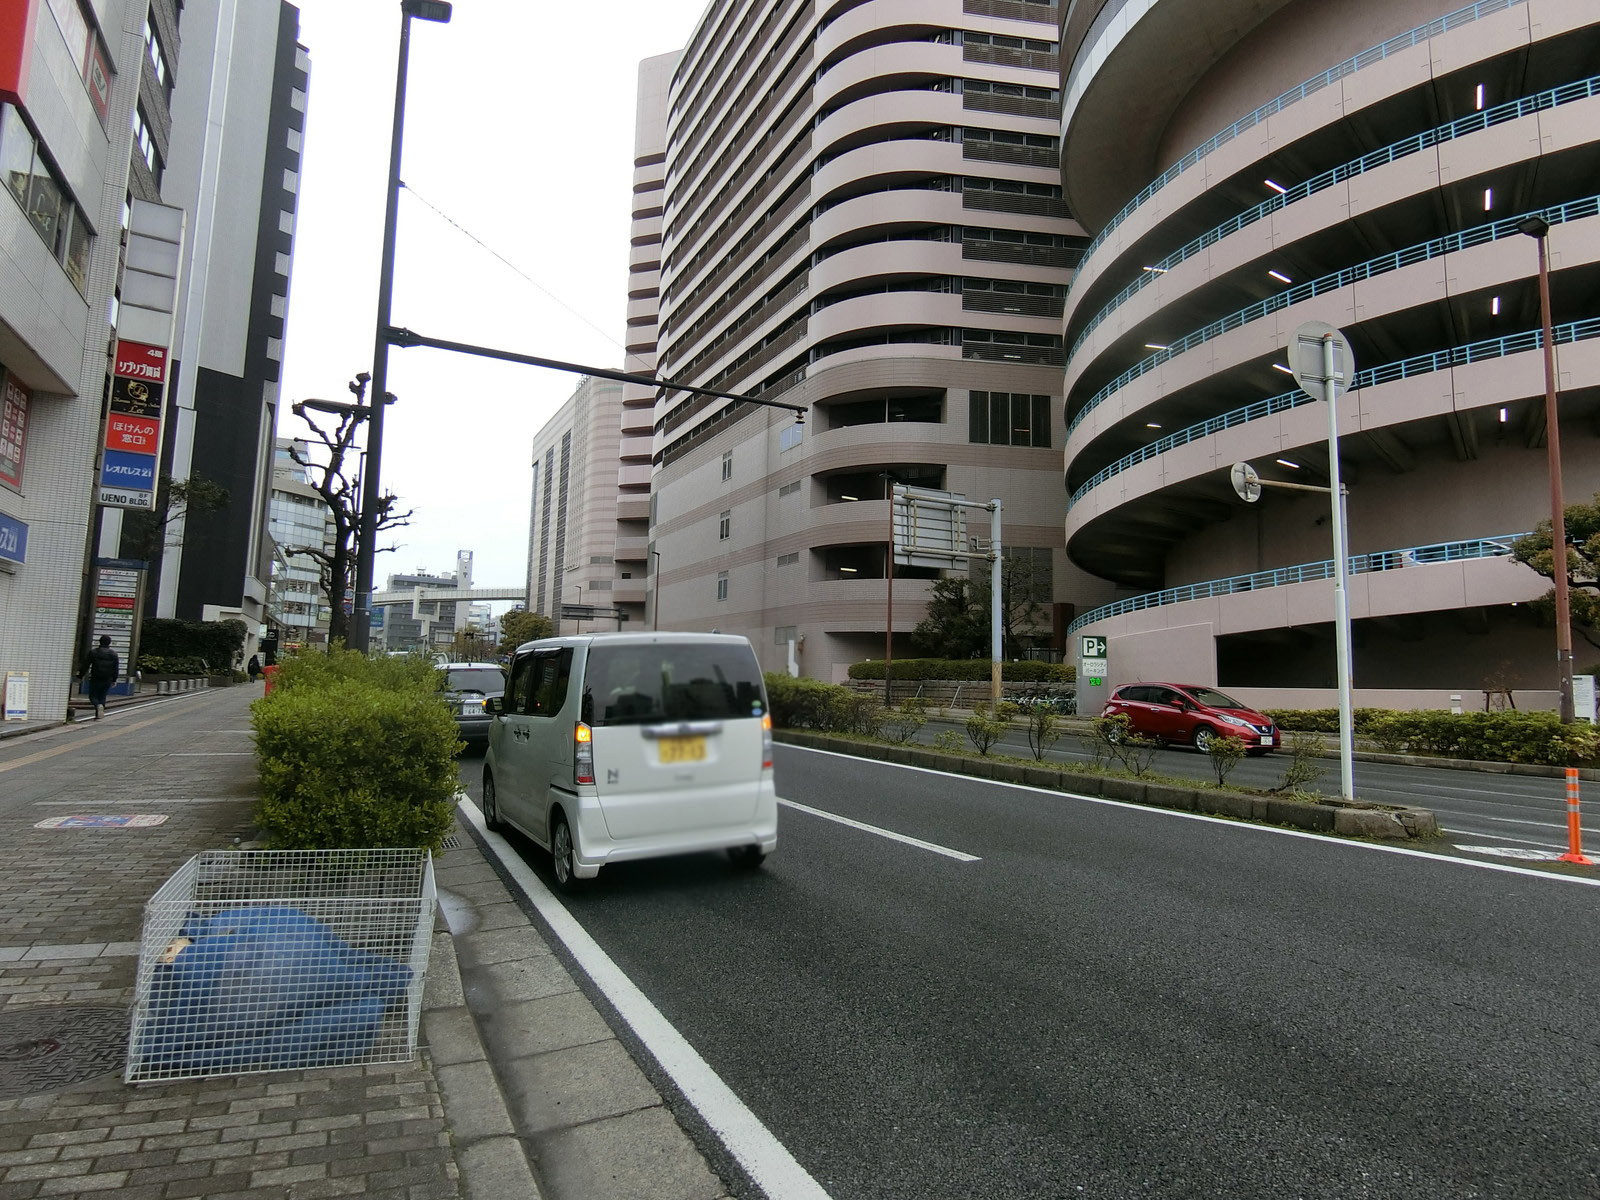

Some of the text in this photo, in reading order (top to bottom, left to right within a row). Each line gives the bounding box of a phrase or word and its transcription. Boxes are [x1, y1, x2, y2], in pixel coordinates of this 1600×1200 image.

[128, 405, 144, 414] Lee
[113, 421, 154, 435] ほけんの
[122, 434, 142, 444] 窓口
[105, 464, 151, 477] レオパレス21
[101, 493, 149, 506] UENO BLDG.
[1087, 640, 1095, 653] P
[607, 768, 619, 780] N
